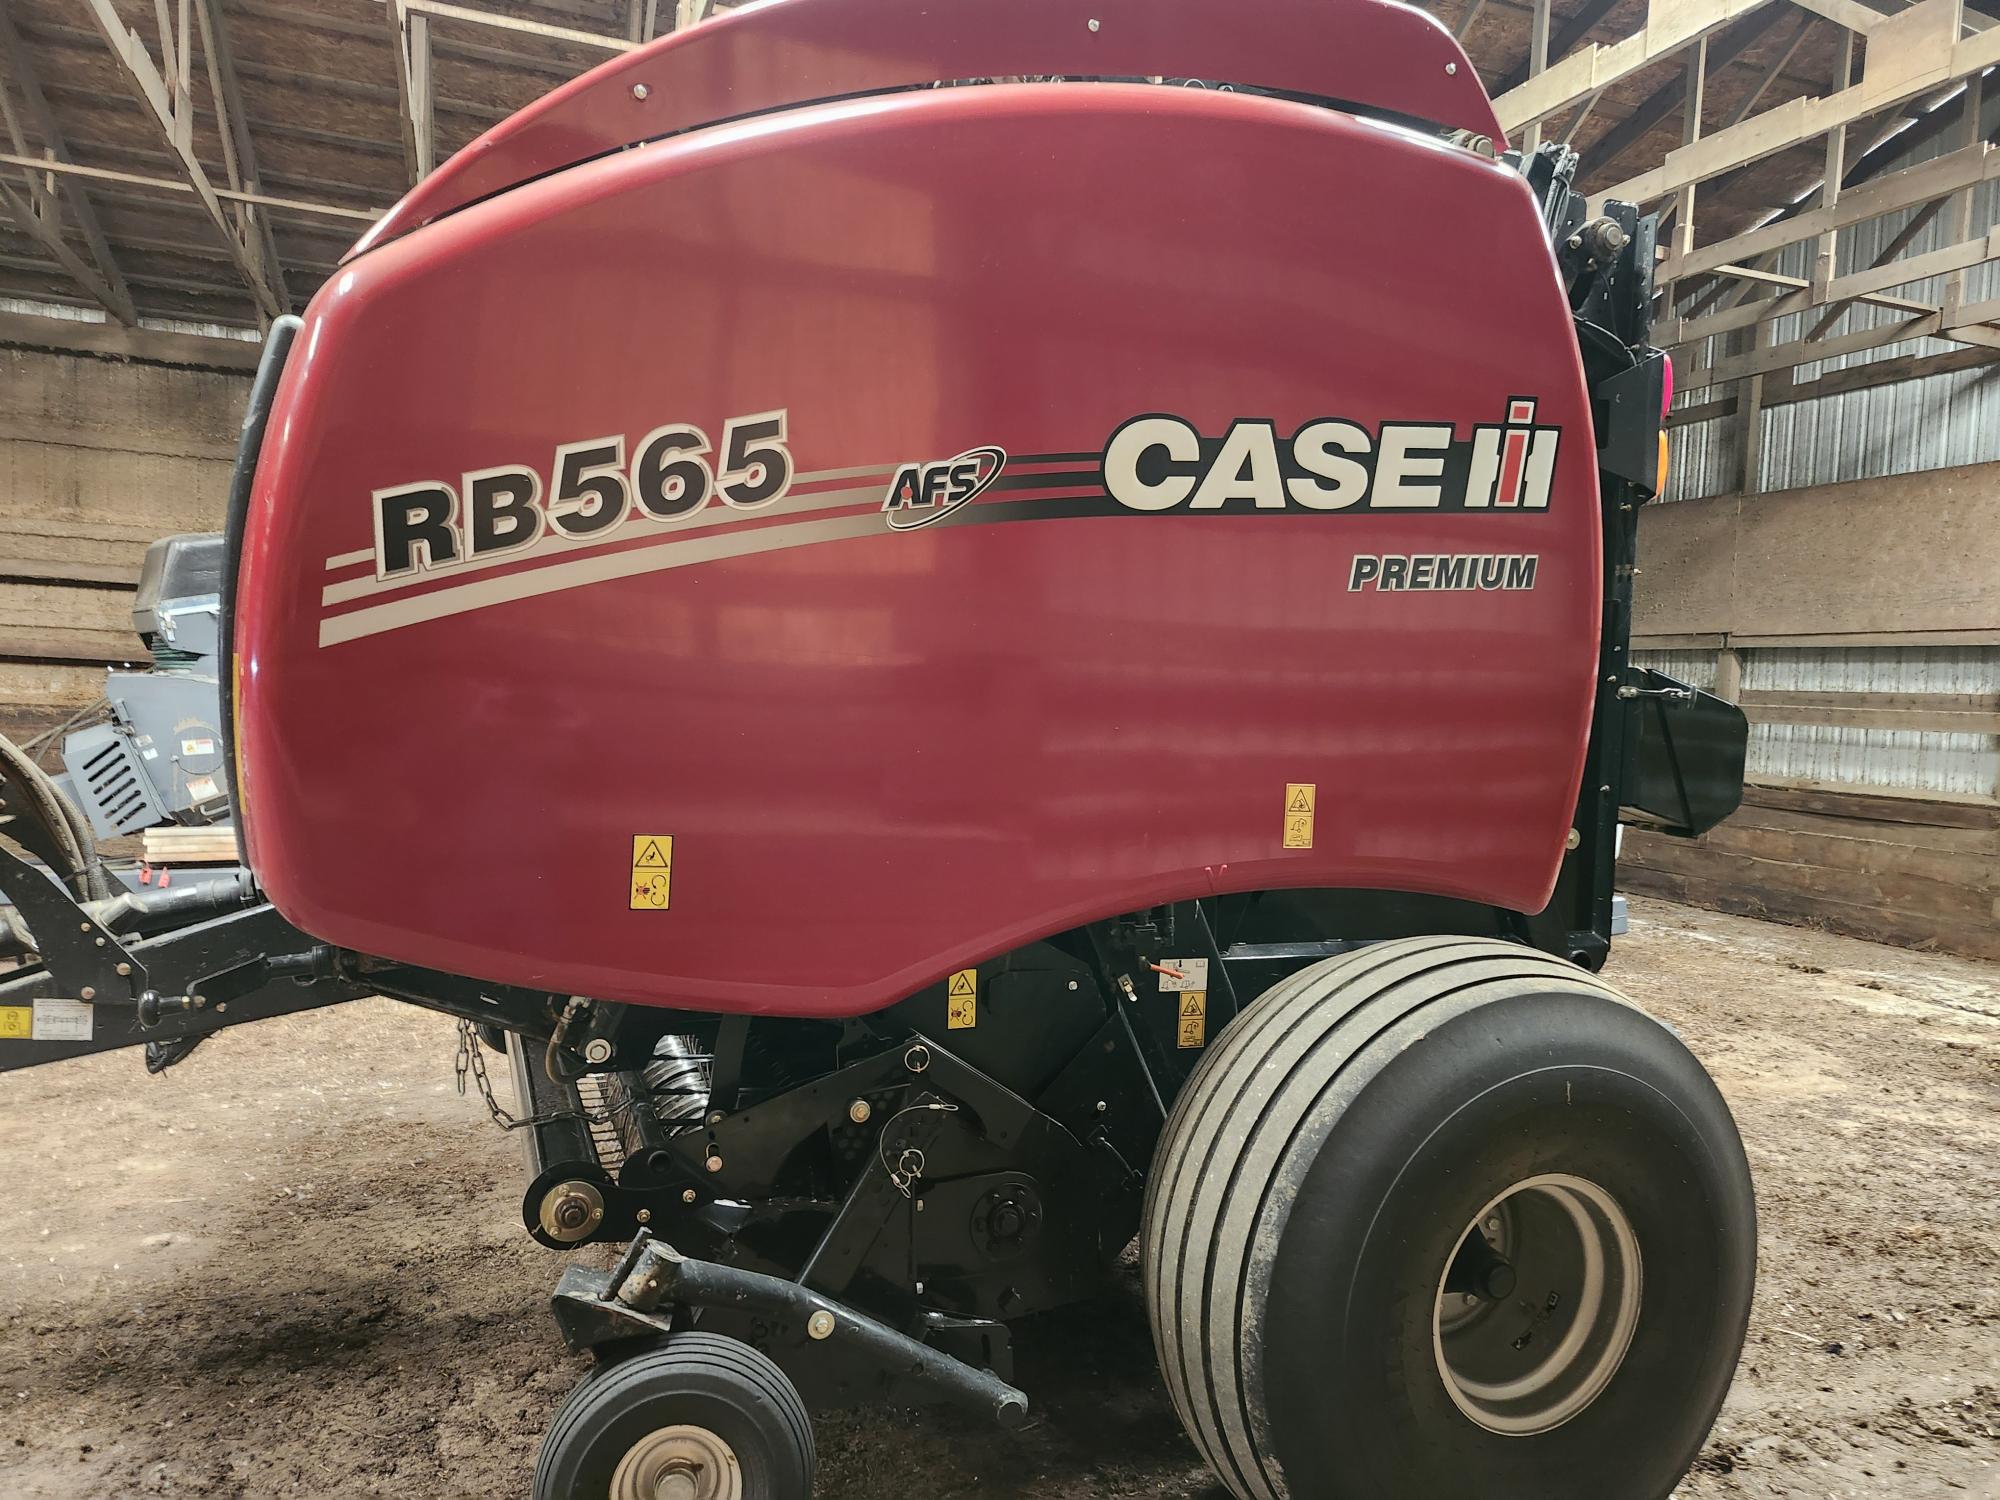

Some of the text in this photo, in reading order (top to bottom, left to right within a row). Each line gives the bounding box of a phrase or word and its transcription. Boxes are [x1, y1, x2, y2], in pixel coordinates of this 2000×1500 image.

[371, 408, 795, 582] RB565
[881, 456, 982, 513] AFS
[1104, 417, 1452, 510] CASE
[1347, 554, 1539, 592] PREMIUM
